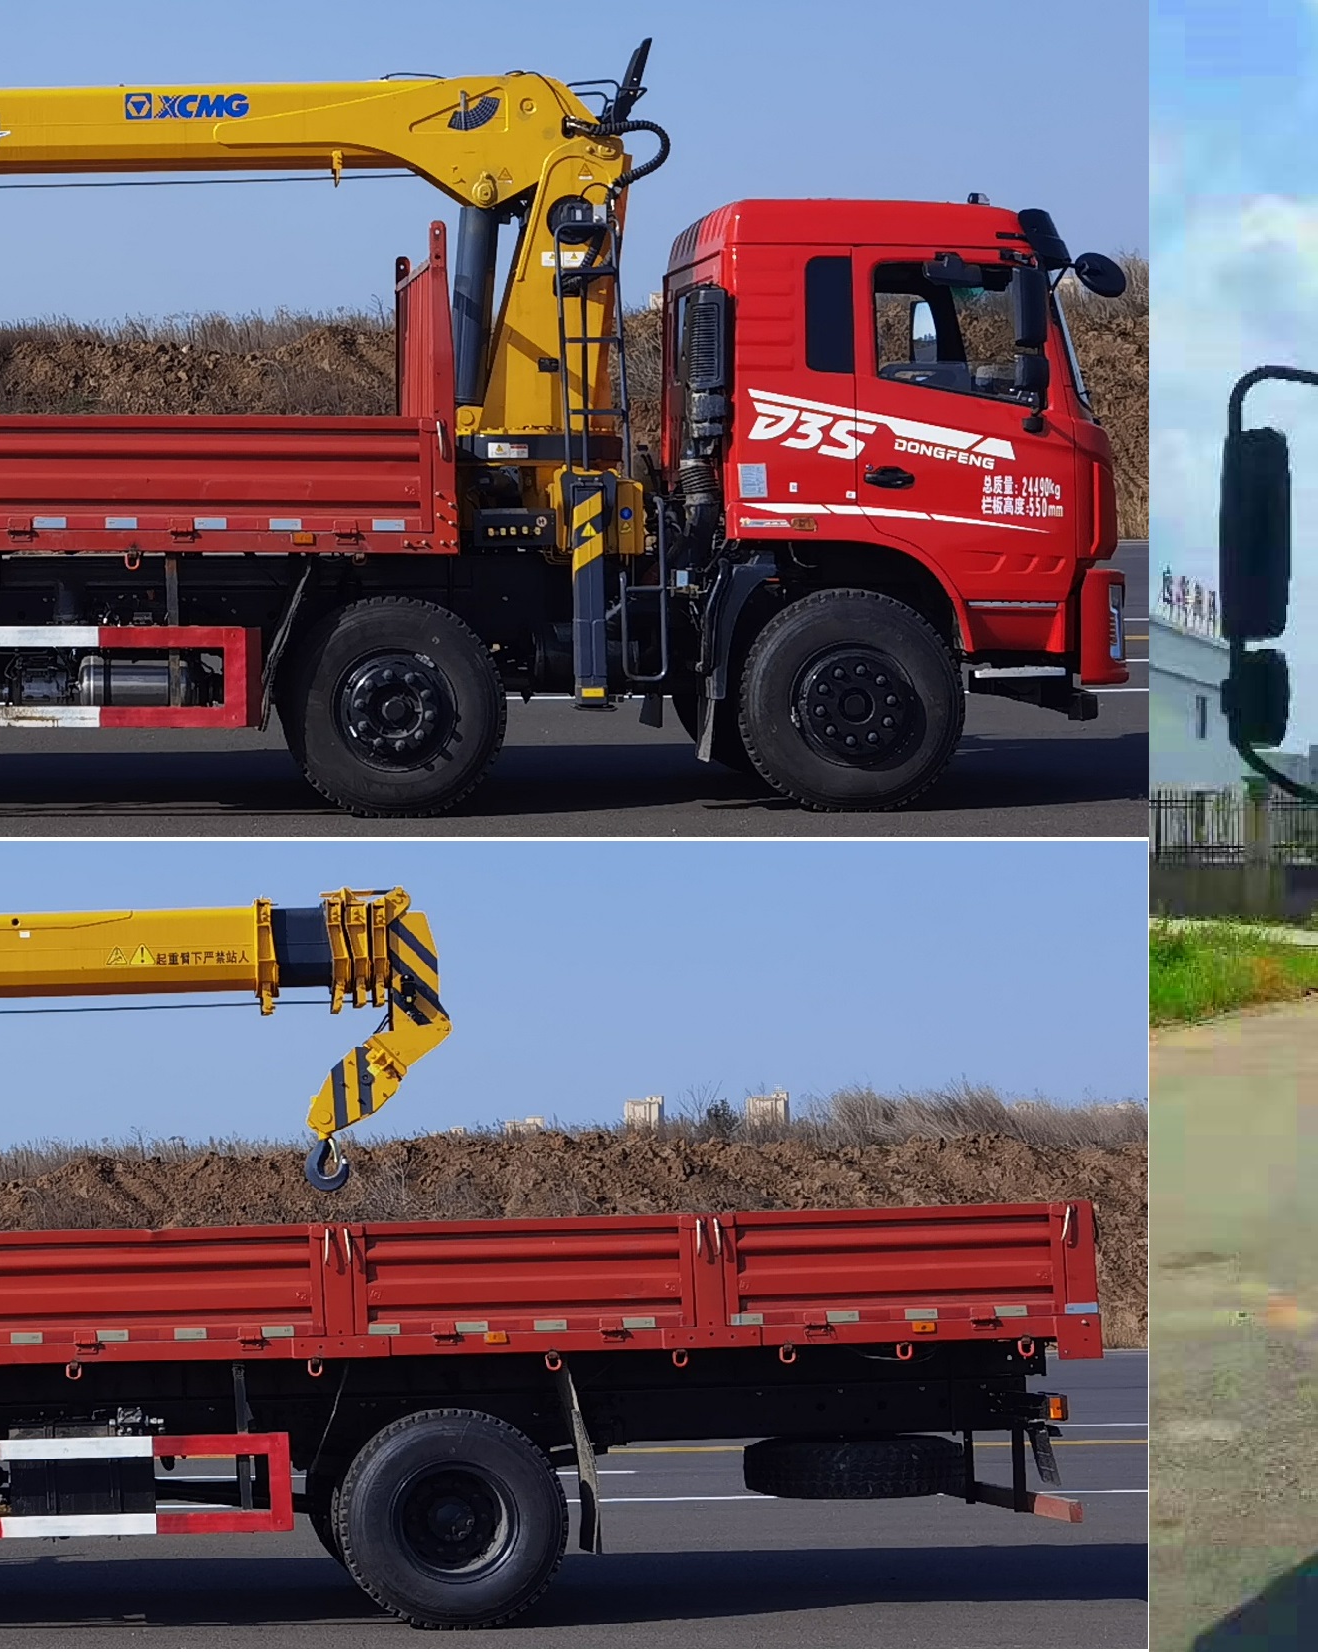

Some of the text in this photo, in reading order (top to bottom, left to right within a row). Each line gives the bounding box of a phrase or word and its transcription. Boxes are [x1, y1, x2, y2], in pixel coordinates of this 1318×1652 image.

[154, 94, 250, 118] XCMG
[748, 401, 877, 459] D3S
[894, 438, 995, 470] DONGFENG
[156, 950, 249, 966] 起重臂下严禁站人
